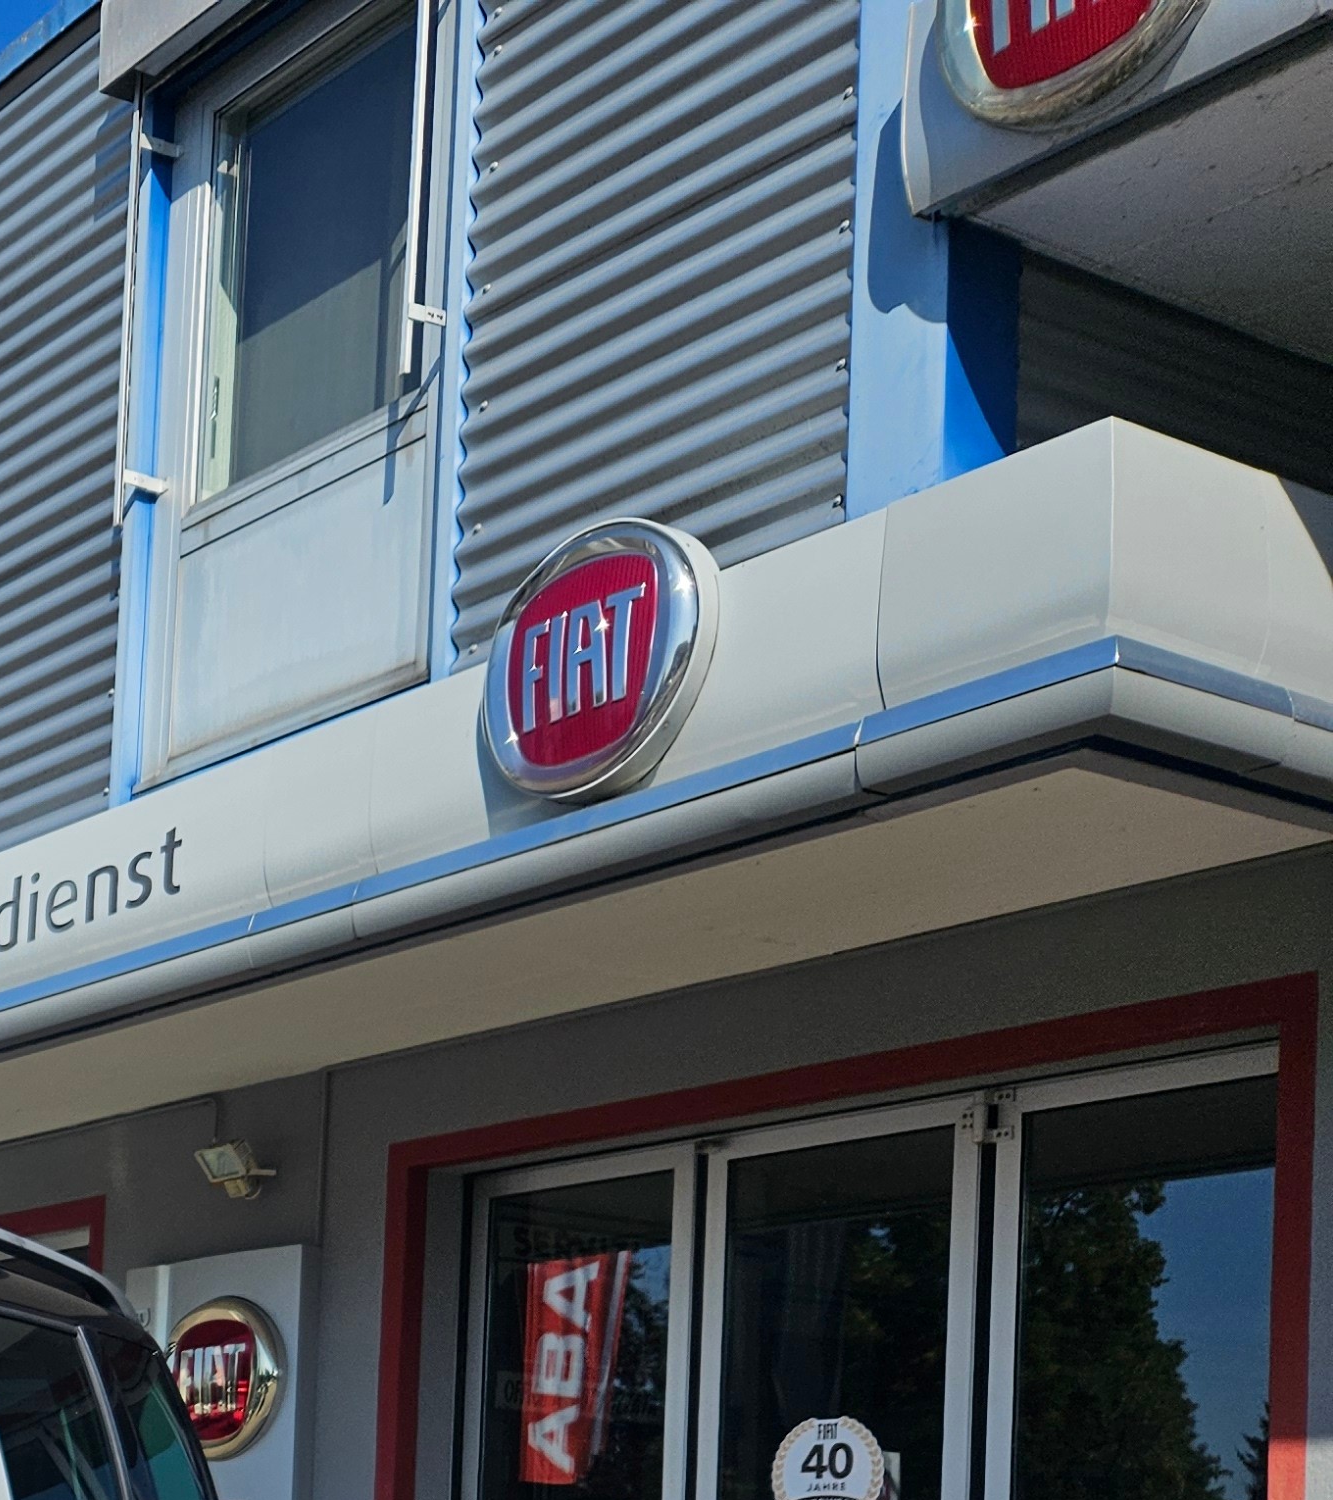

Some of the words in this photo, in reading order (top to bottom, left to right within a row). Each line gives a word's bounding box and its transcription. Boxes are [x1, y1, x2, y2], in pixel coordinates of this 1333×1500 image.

[523, 583, 646, 733] FIAT
[178, 1343, 246, 1415] FIAT
[817, 1423, 839, 1440] FIAT
[801, 1442, 854, 1479] 40
